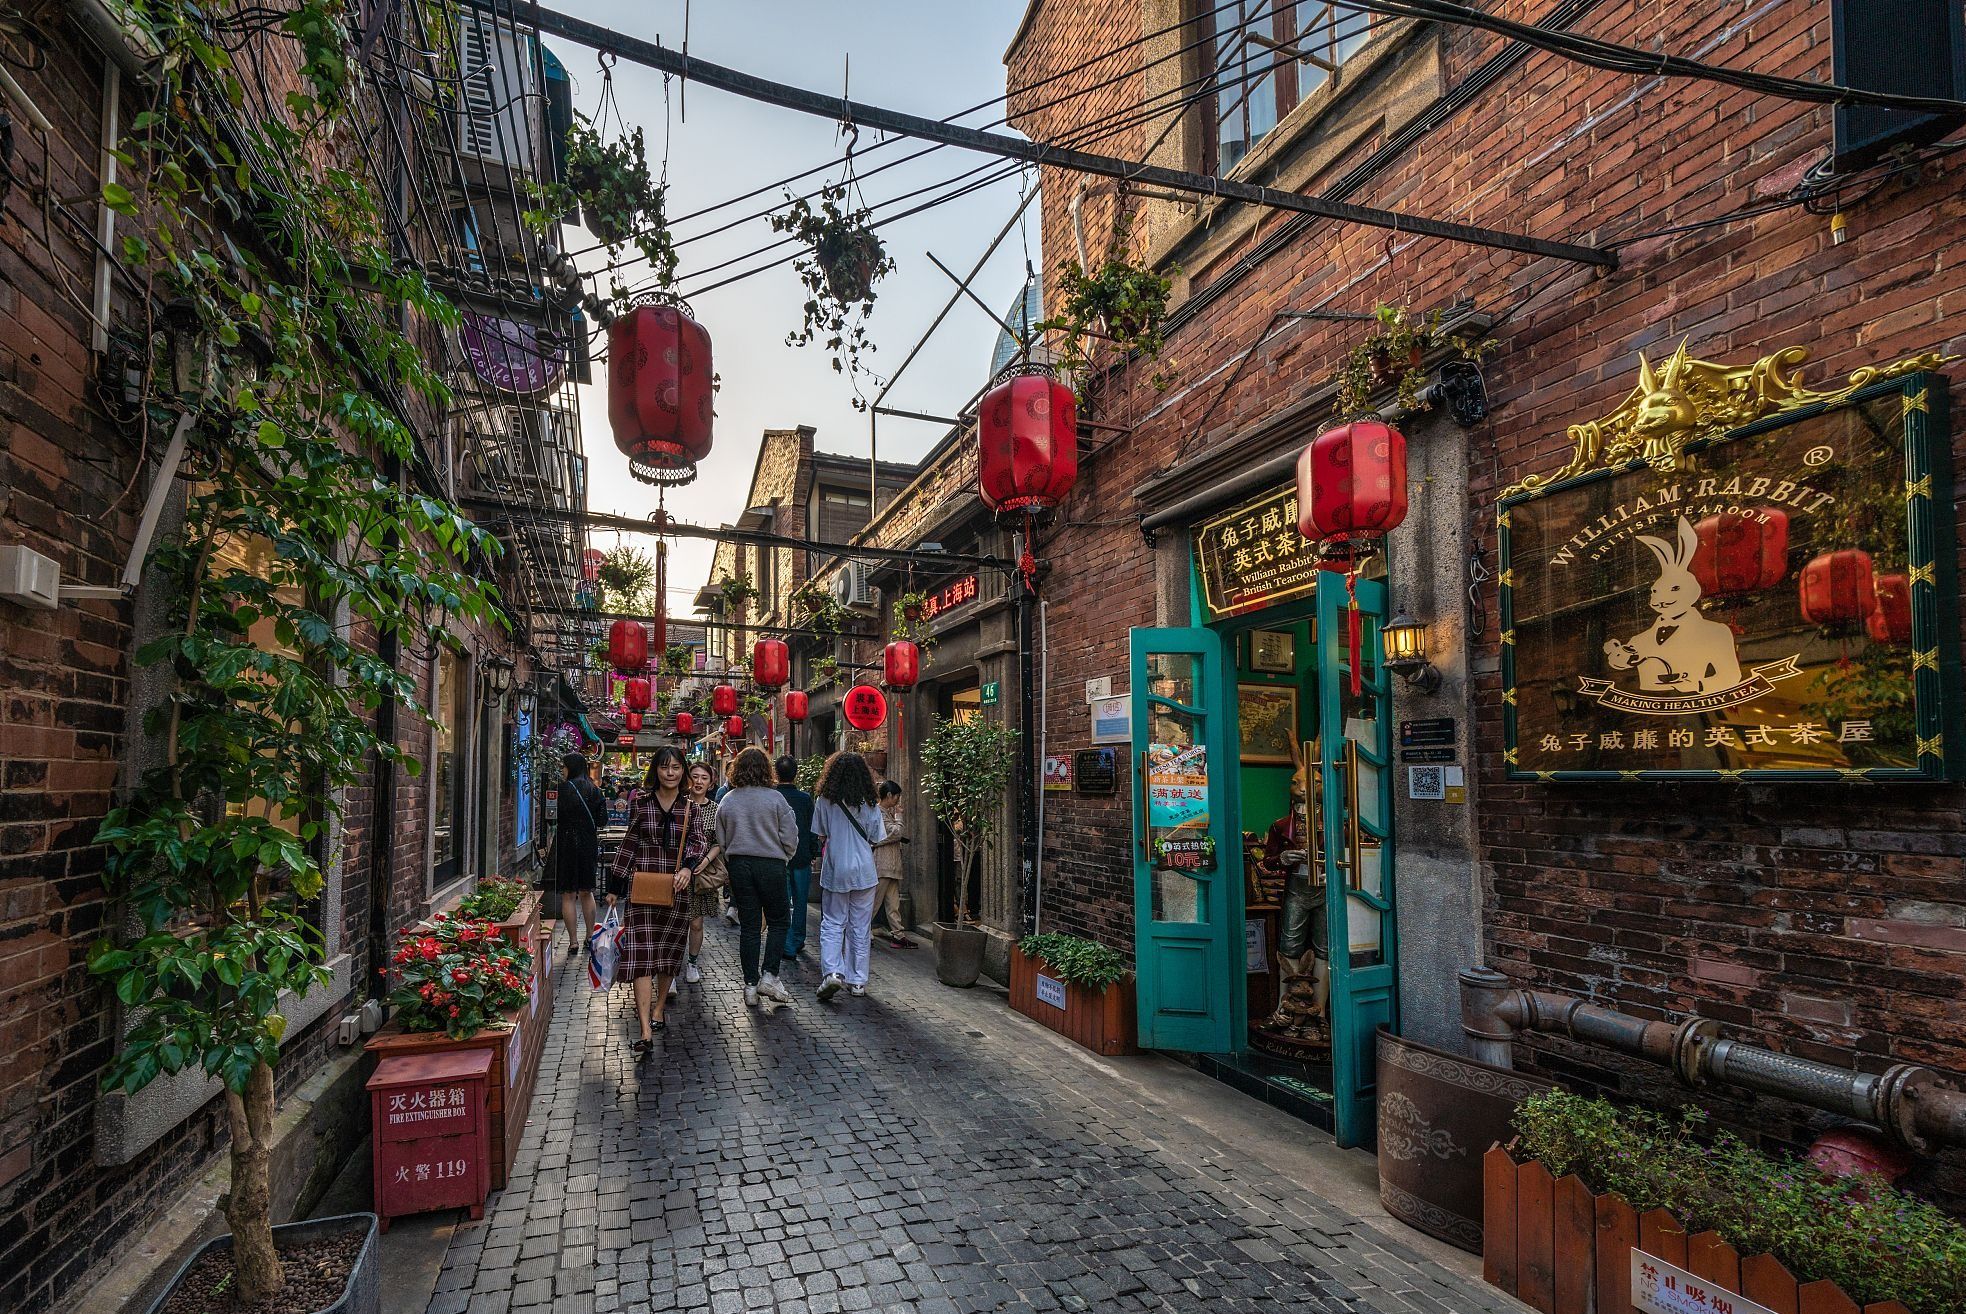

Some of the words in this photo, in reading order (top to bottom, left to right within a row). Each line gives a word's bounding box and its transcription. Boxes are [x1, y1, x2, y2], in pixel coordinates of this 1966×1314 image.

[1590, 514, 1658, 561] BRITISH
[1671, 503, 1772, 526] TEAROOM
[1233, 531, 1316, 573] 英式茶
[1241, 568, 1277, 585] William
[1243, 582, 1273, 597] British
[1274, 568, 1319, 586] Tearoom
[985, 685, 994, 698] 46
[1610, 693, 1661, 710] MAKING
[1663, 694, 1728, 711] HEALTHY
[1730, 684, 1759, 702] TEA
[1540, 720, 1875, 753] 兔子威廉的英式茶屋
[1152, 788, 1204, 801] 满就送
[389, 1088, 466, 1112] 灭火器箱
[389, 1113, 405, 1125] FIRE
[405, 1109, 452, 1123] EXTINGUISHER
[452, 1106, 466, 1117] BOX
[1640, 1277, 1660, 1293] NO
[1640, 1262, 1733, 1314] 禁止吸烟
